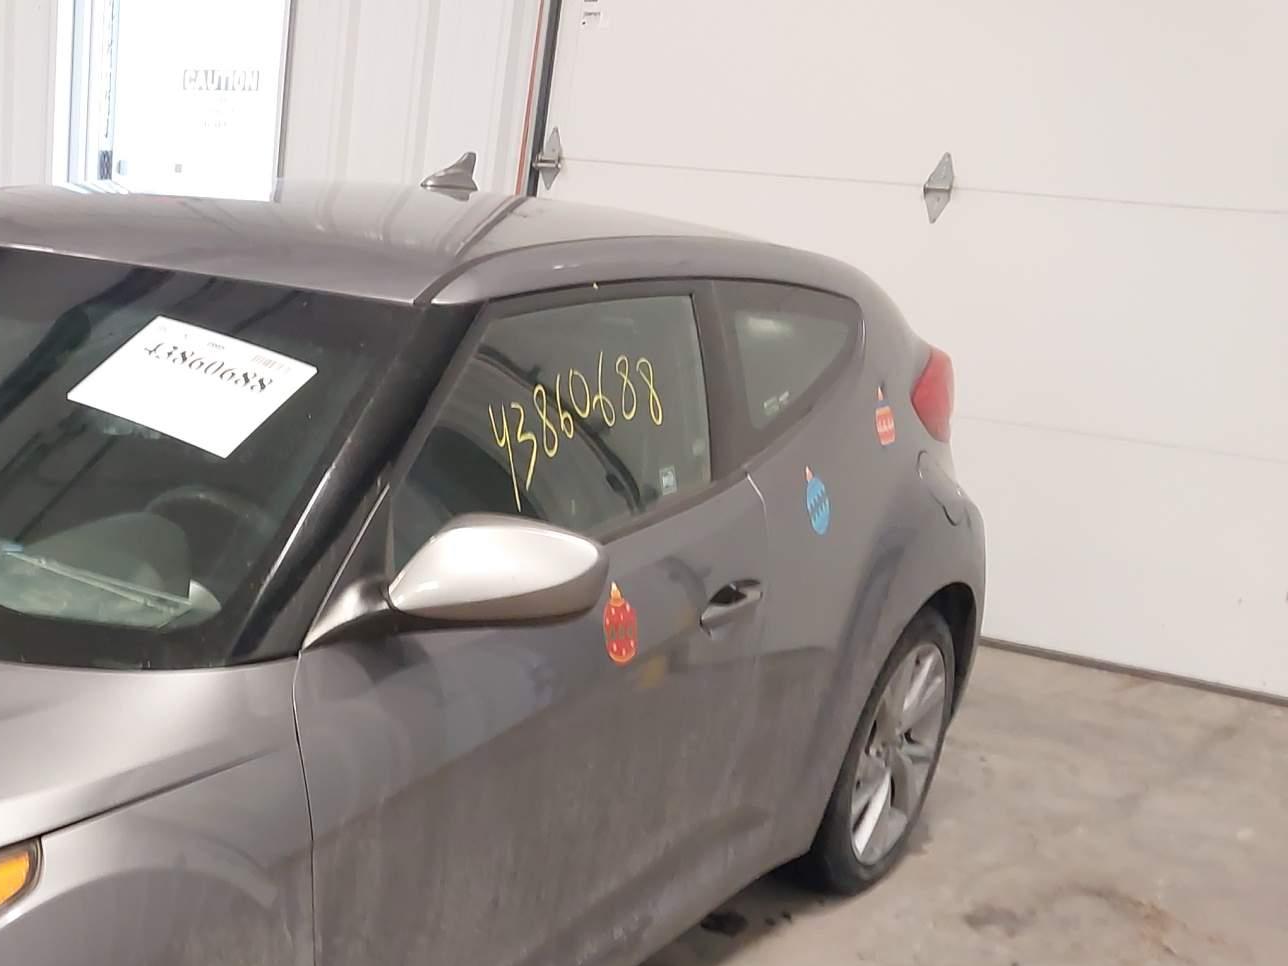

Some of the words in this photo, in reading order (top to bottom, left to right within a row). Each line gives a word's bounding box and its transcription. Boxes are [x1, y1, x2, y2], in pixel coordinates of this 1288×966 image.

[182, 69, 261, 92] CAUTION
[143, 341, 274, 393] 43860688
[488, 351, 663, 513] 43860688
